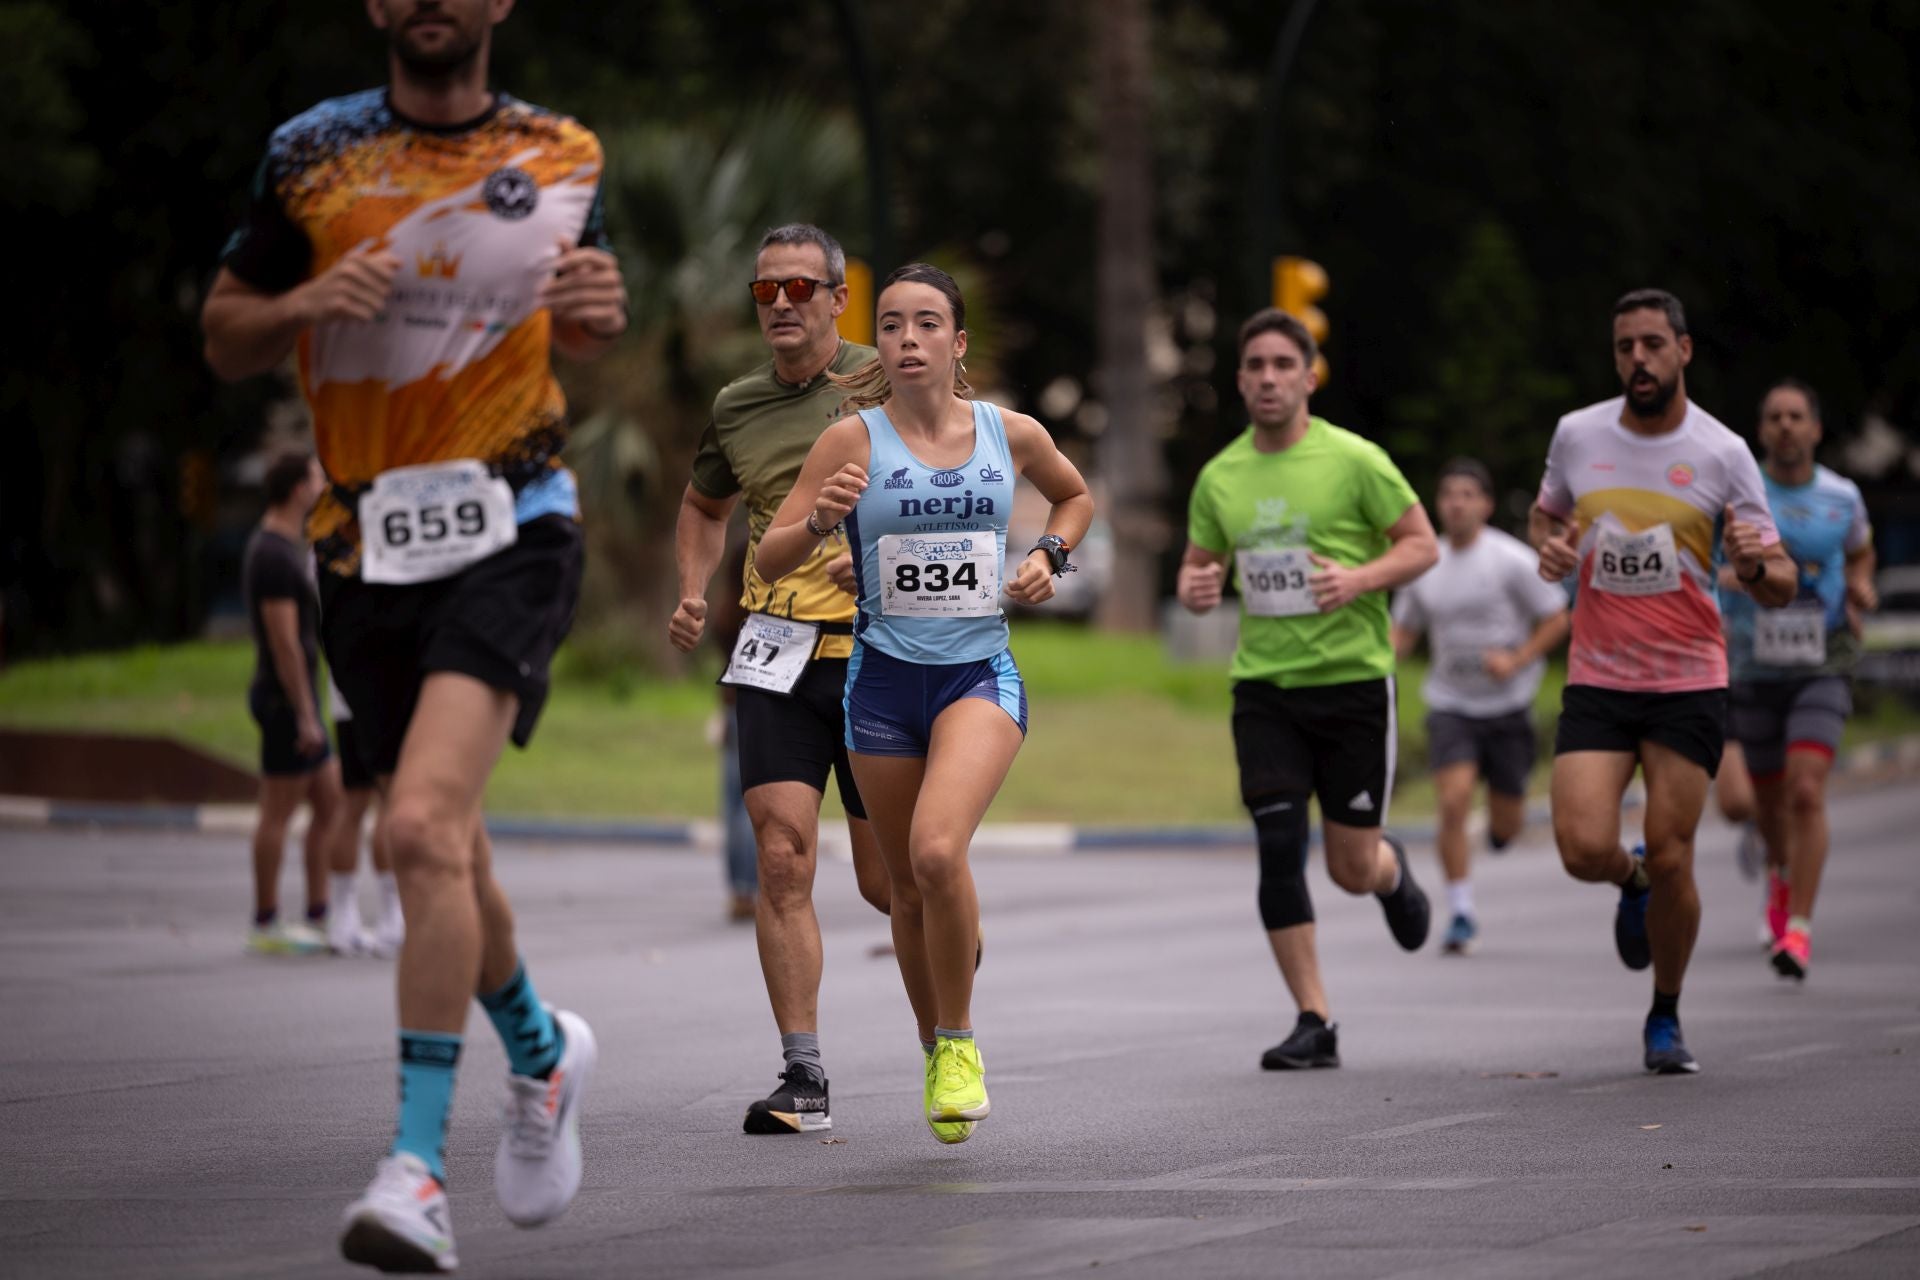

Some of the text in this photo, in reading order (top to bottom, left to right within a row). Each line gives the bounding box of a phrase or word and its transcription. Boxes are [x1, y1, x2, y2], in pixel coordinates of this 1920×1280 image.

[932, 473, 962, 485] TROPS
[899, 490, 994, 519] nerja
[383, 501, 486, 547] 659
[913, 522, 979, 532] ATLETISMO
[913, 541, 962, 554] Carrera
[923, 552, 966, 560] Prensa
[1602, 552, 1662, 575] 664
[896, 562, 978, 592] 834
[1247, 569, 1305, 593] 1093
[740, 638, 780, 667] 47
[793, 1097, 826, 1110] BROOKS
